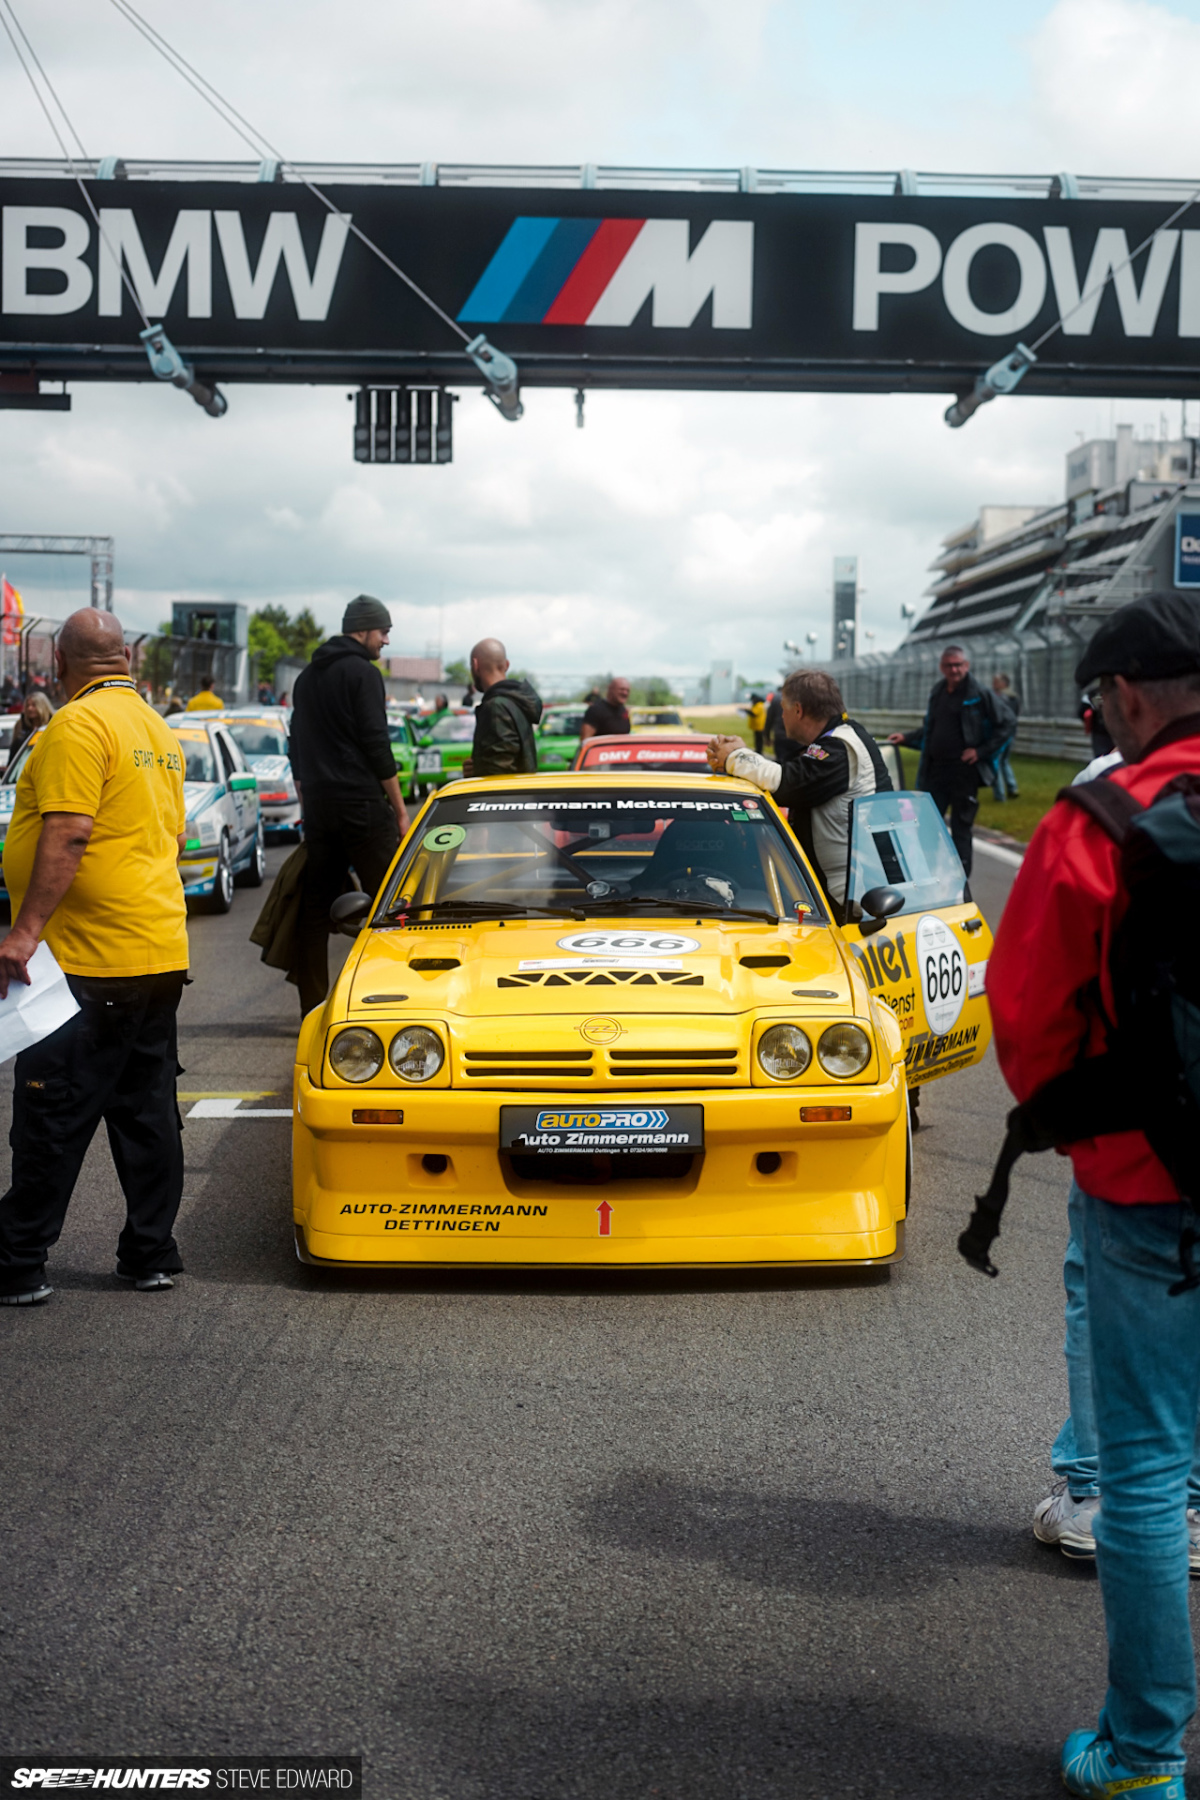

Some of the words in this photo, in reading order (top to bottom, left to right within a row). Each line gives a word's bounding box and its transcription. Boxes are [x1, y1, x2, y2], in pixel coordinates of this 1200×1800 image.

[1, 205, 352, 321] BMW
[586, 218, 755, 330] M
[852, 221, 1200, 338] POW
[599, 750, 631, 761] DMV
[637, 750, 680, 760] Classic
[467, 802, 612, 812] Zimmermann
[617, 800, 742, 811] Motorsport
[434, 832, 453, 845] C
[571, 937, 686, 950] 666
[926, 950, 962, 1003] 666
[904, 1024, 980, 1067] ZIMMERMANN
[518, 1133, 561, 1146] Auto
[565, 1132, 689, 1145] Zimmermann
[340, 1204, 548, 1216] AUTO-ZIMMERMANN
[384, 1220, 500, 1231] DETTINGEN
